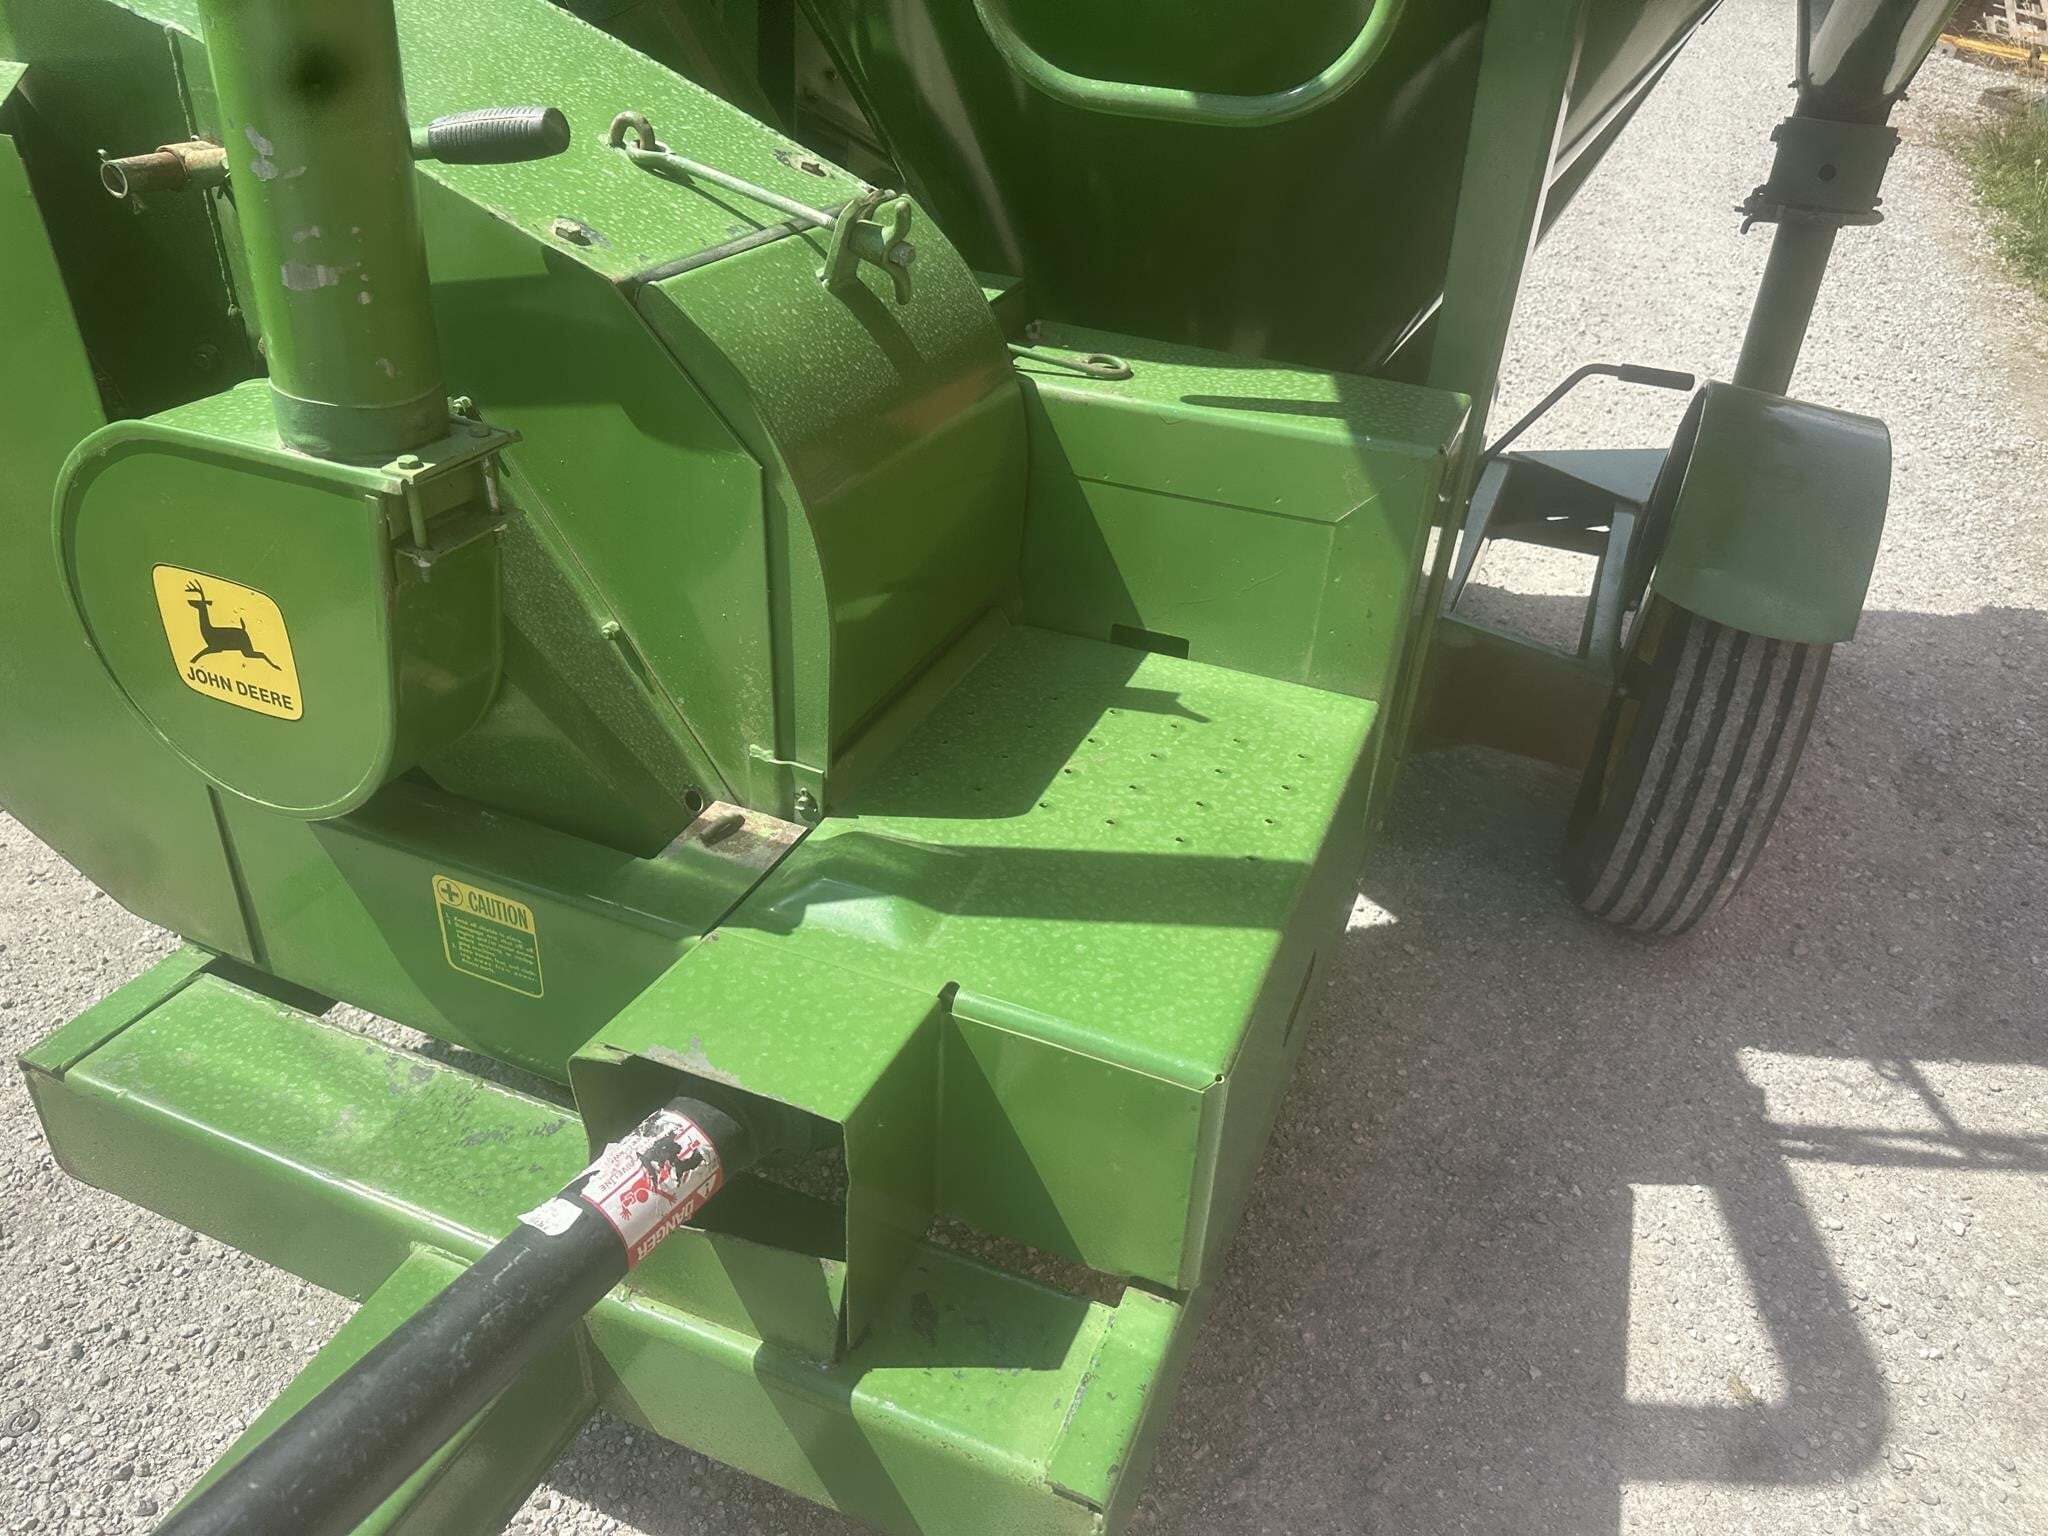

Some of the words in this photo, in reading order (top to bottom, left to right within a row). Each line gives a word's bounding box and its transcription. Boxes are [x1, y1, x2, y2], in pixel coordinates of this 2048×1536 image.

[187, 667, 233, 692] JOHN
[236, 680, 294, 710] DEERE
[468, 891, 529, 929] CAUTION
[637, 1199, 694, 1261] DANGER
